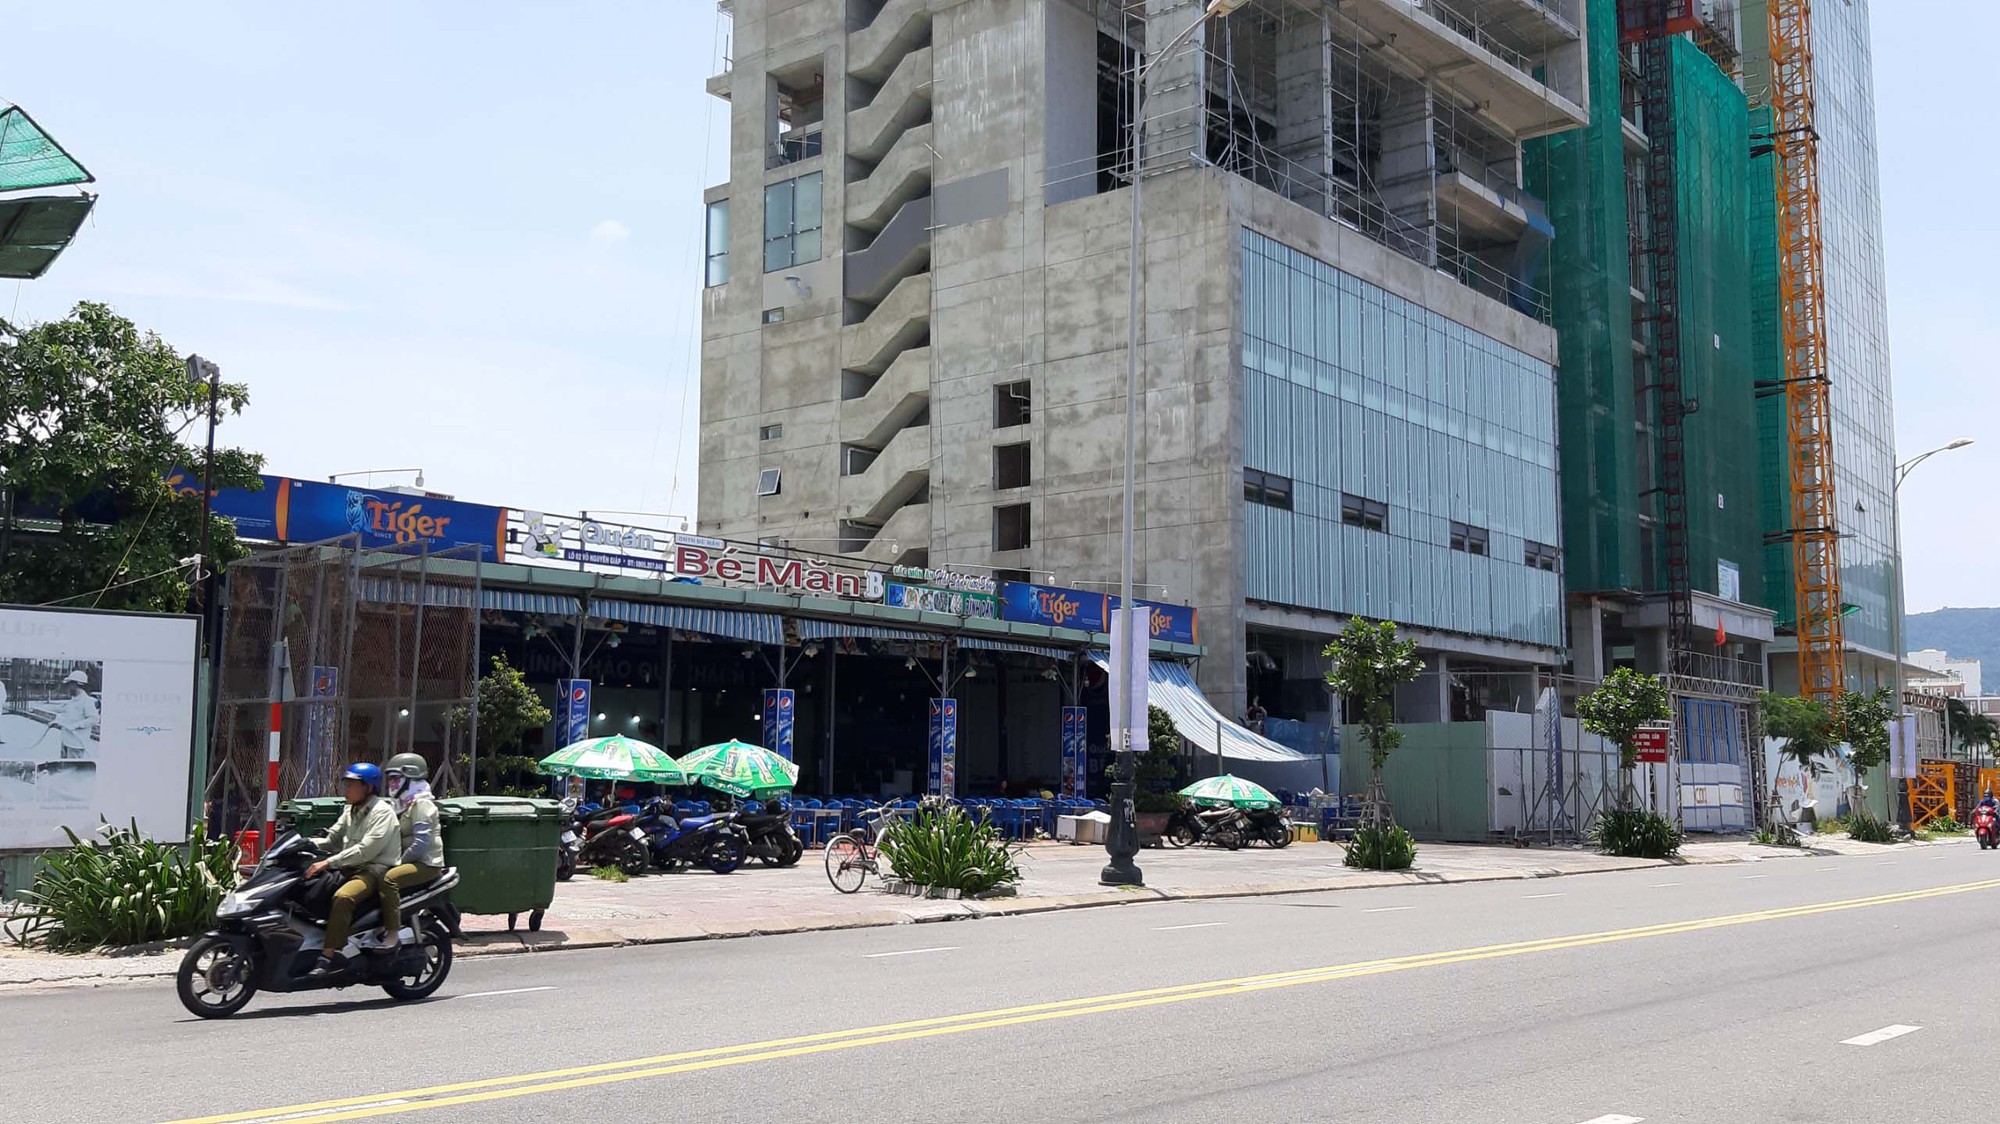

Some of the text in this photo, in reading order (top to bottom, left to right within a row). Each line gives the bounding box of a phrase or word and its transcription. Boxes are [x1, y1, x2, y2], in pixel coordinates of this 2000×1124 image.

[367, 501, 450, 544] Tiger
[581, 521, 654, 551] Quán
[676, 545, 743, 581] Bé
[1040, 592, 1079, 624] Tiger
[1149, 607, 1172, 636] ger
